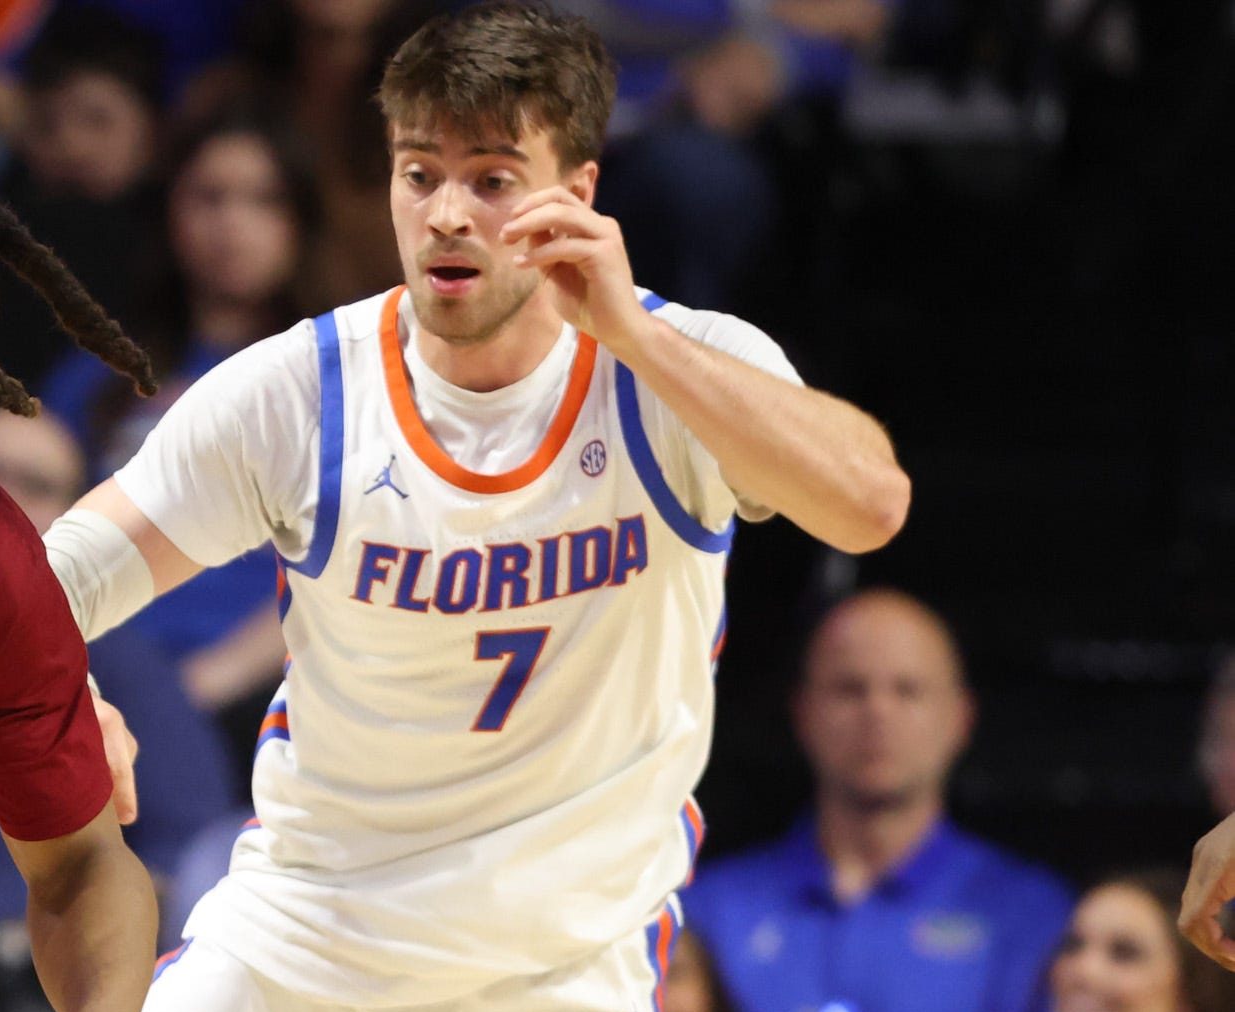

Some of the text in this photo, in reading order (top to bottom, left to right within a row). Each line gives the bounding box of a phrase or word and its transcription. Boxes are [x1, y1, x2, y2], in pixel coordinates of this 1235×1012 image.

[580, 440, 606, 477] SEC
[349, 511, 648, 615] FLORIDA
[469, 625, 552, 732] 7
